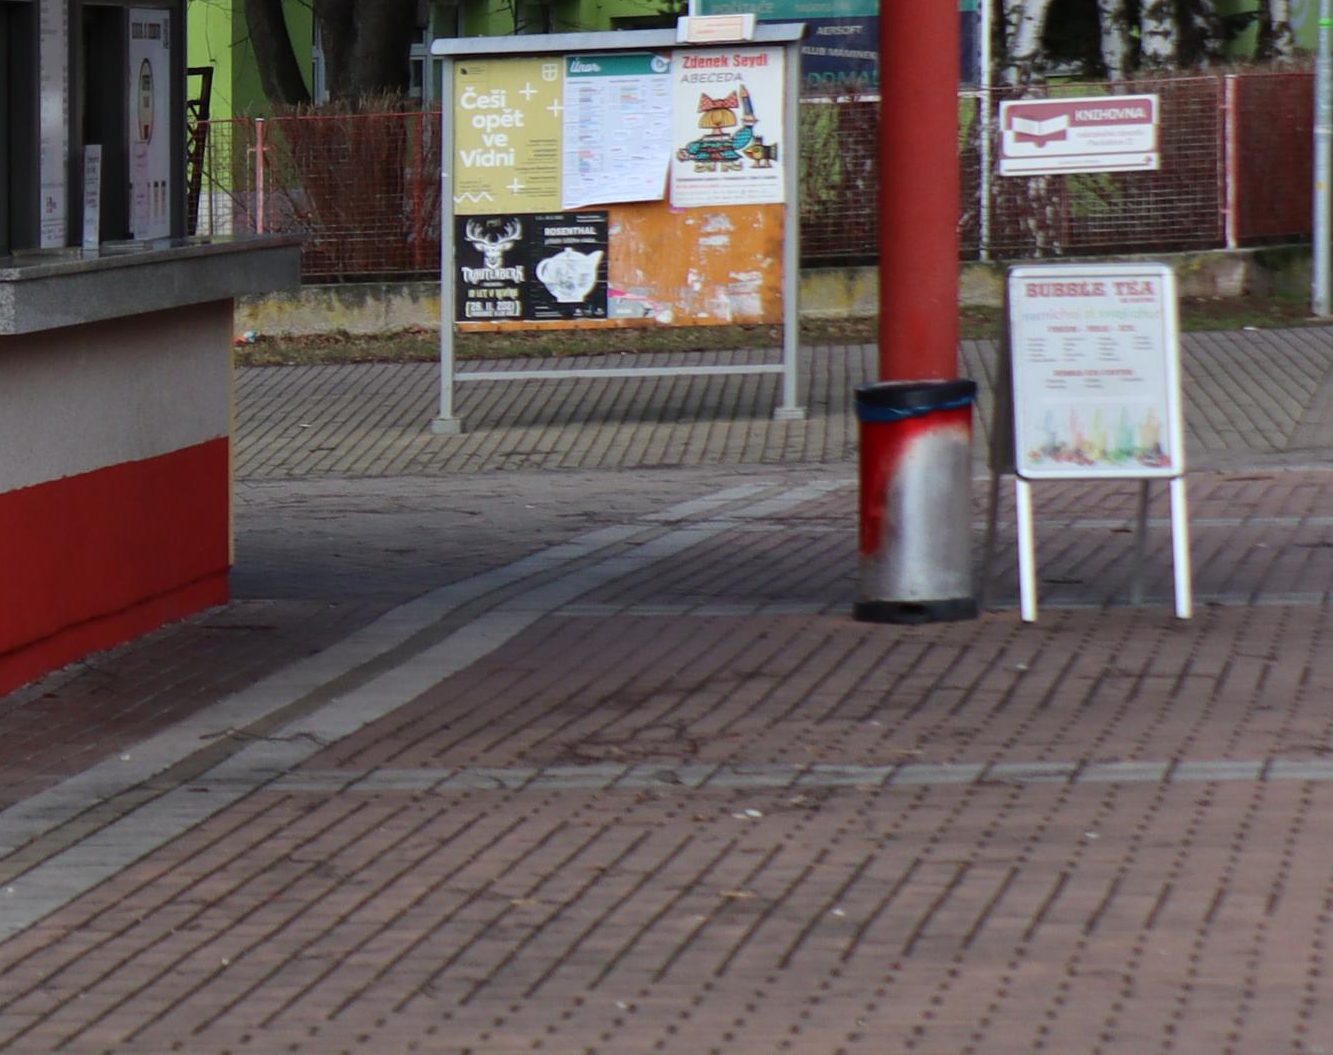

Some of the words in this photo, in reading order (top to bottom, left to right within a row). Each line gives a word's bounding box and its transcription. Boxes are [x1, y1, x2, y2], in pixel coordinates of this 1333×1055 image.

[682, 54, 728, 70] Zdenek
[734, 53, 768, 70] Seydl
[681, 72, 744, 83] ABECEDA
[460, 86, 506, 109] Češi
[472, 109, 524, 132] opět
[1075, 107, 1146, 122] KNIHOVNA
[483, 132, 508, 146] ve
[460, 146, 515, 168] Vídni
[544, 226, 597, 236] ROSENTHAL
[1025, 281, 1106, 298] BUBBLE
[1112, 279, 1155, 297] TEA
